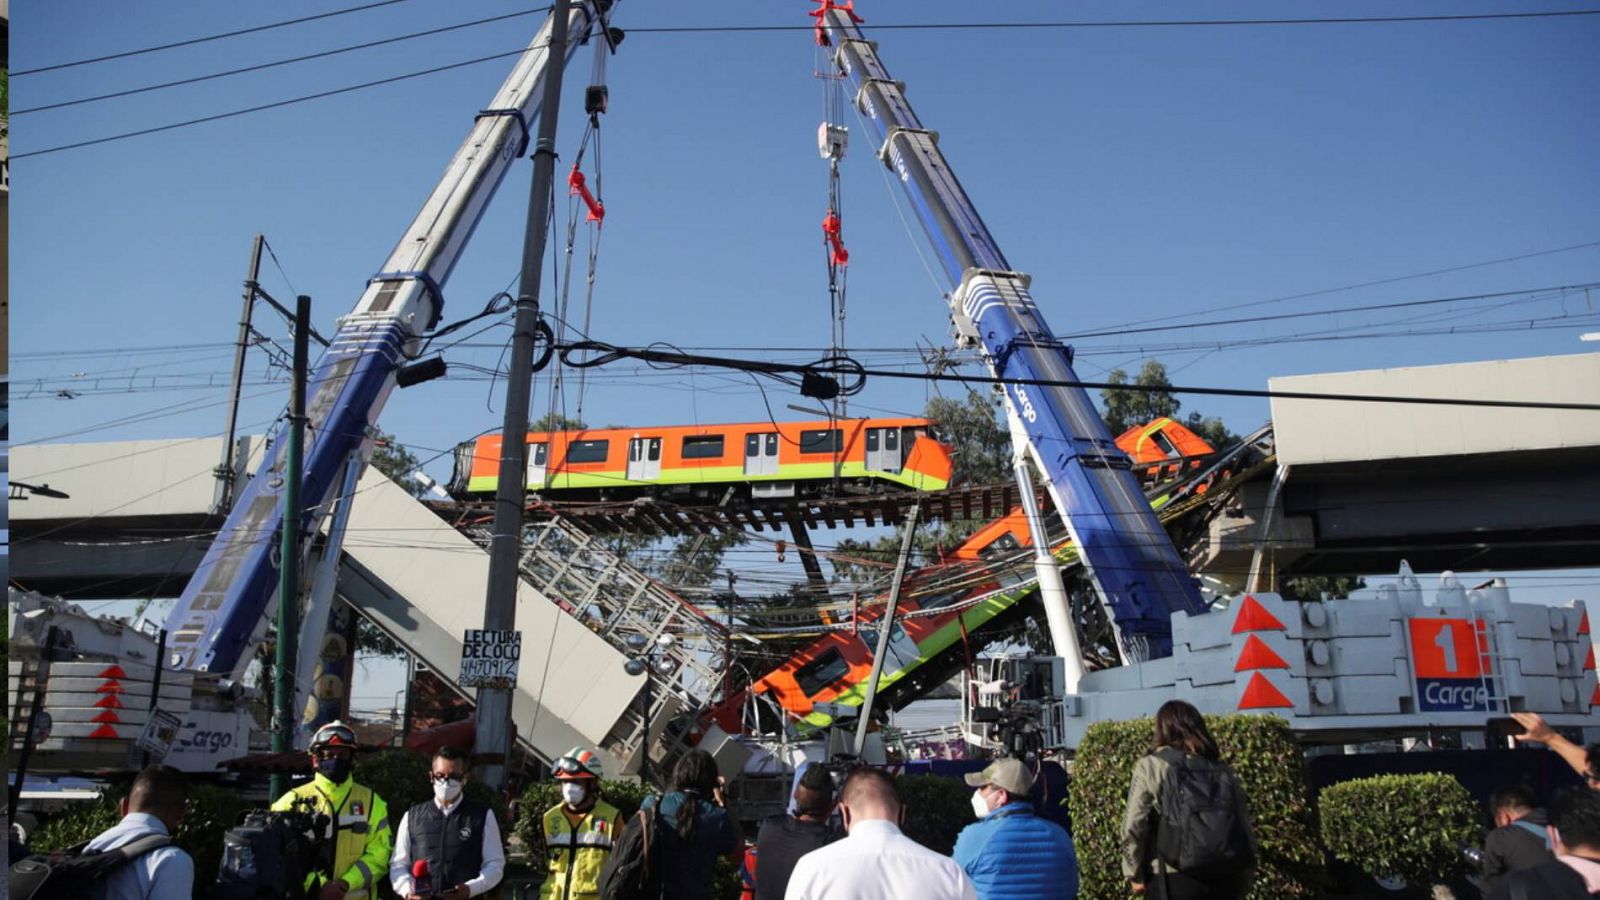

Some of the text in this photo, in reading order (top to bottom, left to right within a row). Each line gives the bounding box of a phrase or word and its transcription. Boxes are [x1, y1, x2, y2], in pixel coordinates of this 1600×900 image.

[464, 629, 522, 645] LECTURA
[1434, 624, 1458, 672] 1
[1425, 682, 1488, 709] Cargo
